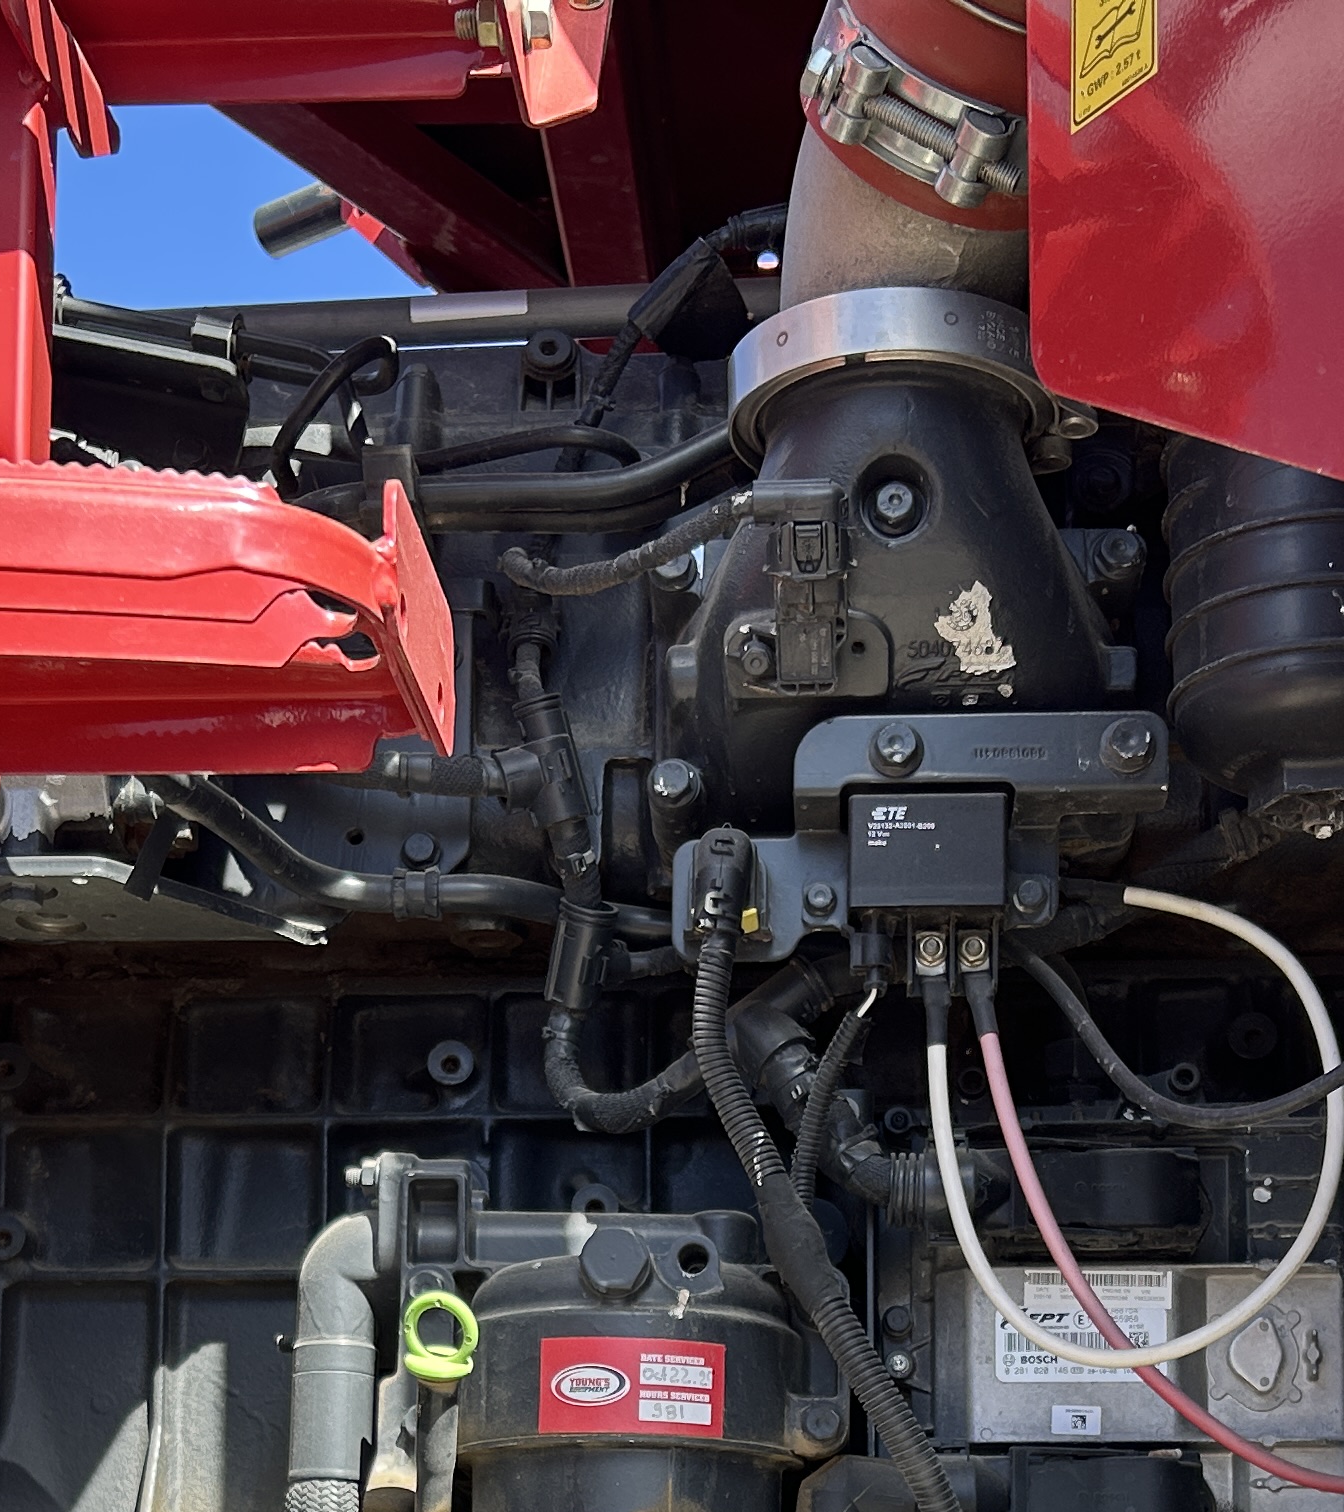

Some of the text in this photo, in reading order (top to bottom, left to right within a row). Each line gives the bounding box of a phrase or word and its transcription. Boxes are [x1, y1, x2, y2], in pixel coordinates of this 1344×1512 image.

[1087, 72, 1109, 97] GWP
[1116, 52, 1134, 76] 2.57
[1020, 1355, 1058, 1364] BOSCH
[569, 1378, 610, 1387] YOUNG'S
